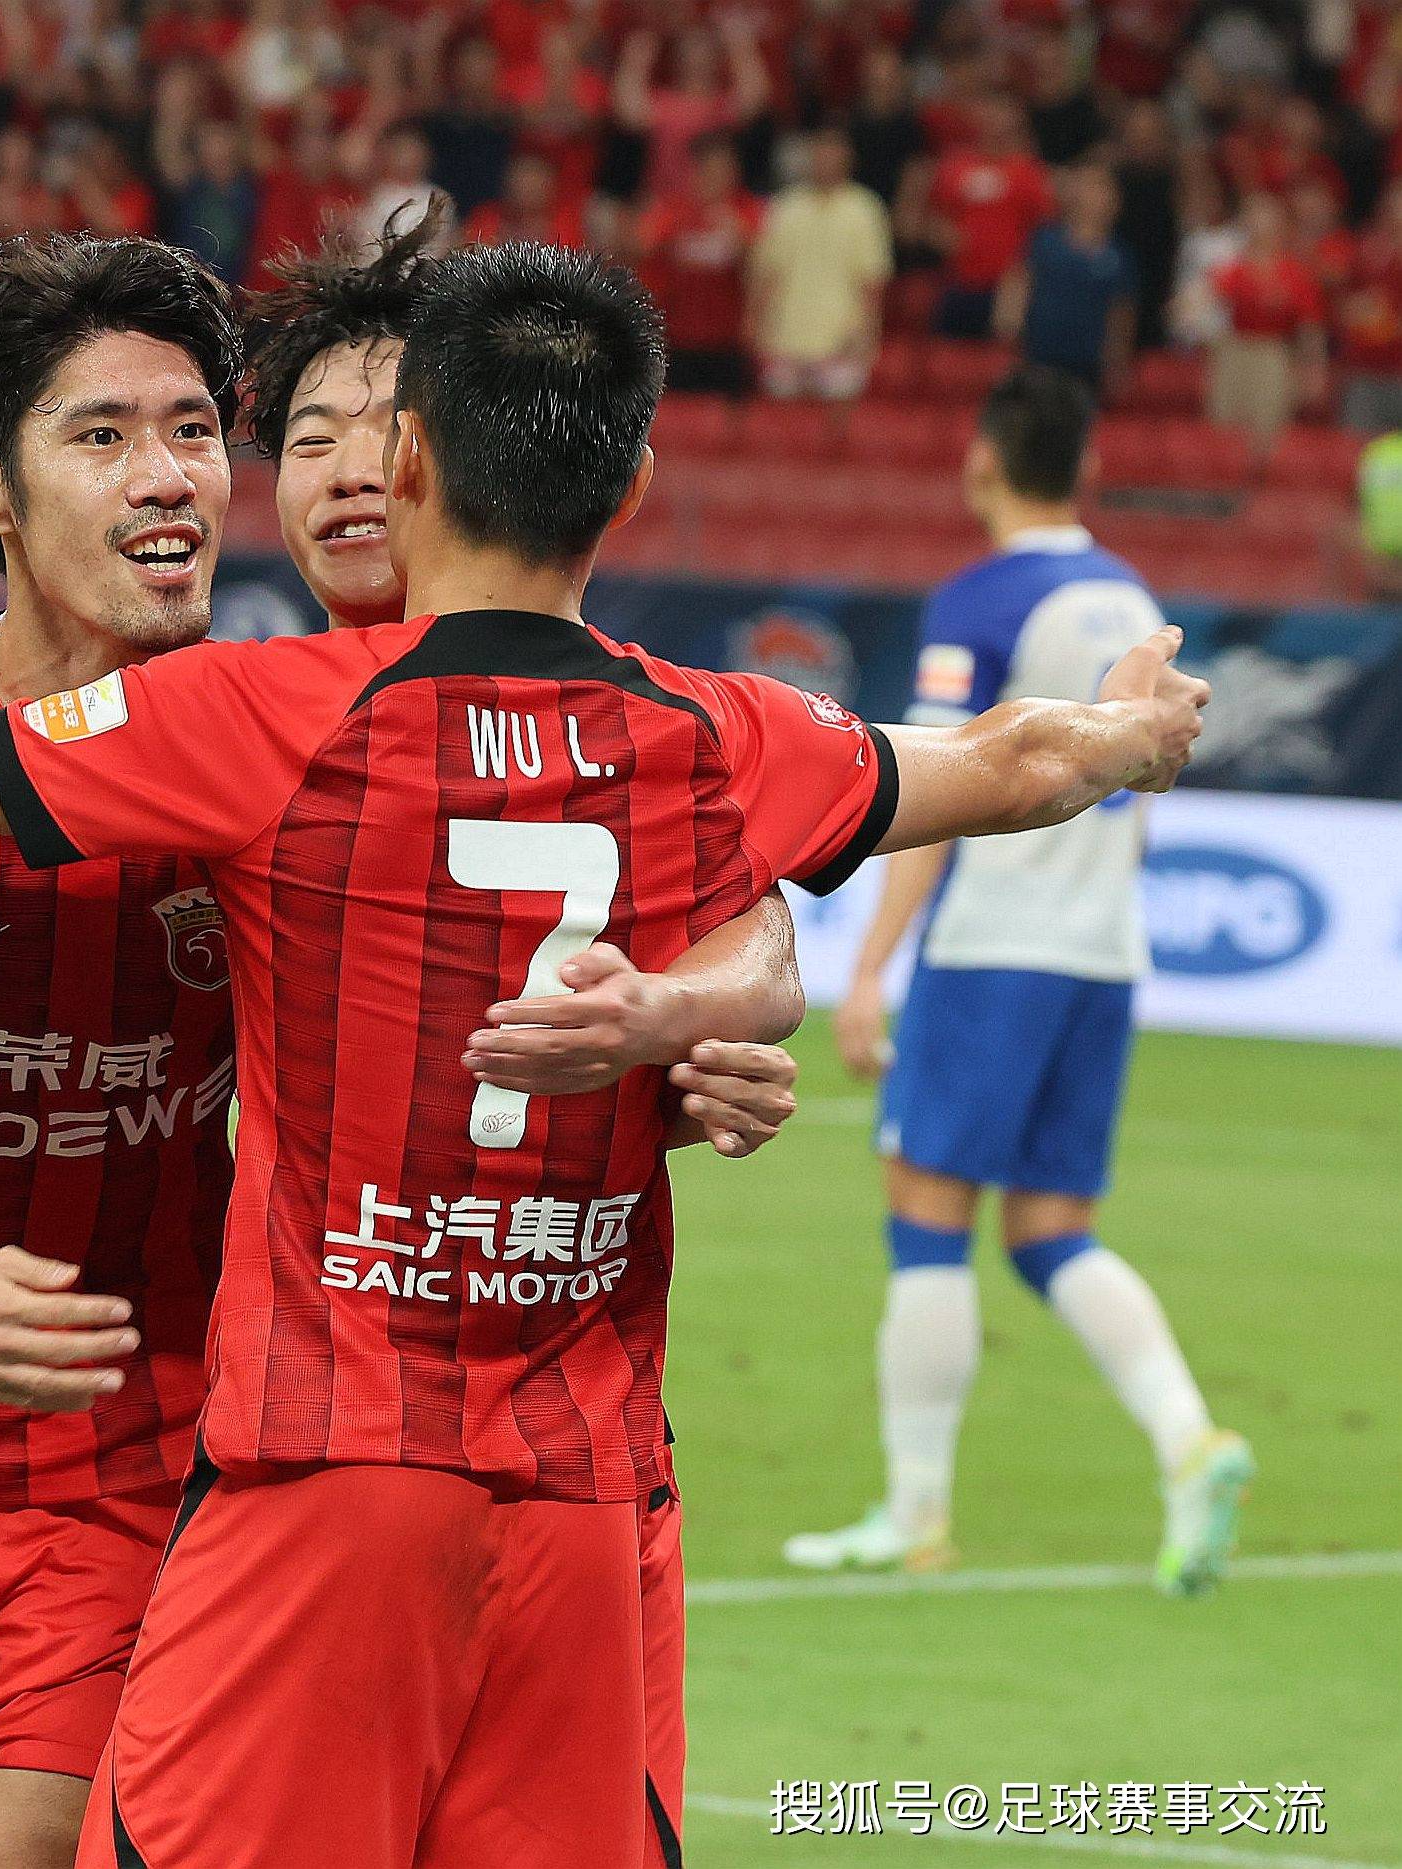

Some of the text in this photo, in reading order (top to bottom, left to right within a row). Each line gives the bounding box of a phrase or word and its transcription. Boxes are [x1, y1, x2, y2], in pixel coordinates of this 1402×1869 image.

[84, 688, 96, 712] CSL
[466, 703, 616, 780] WU L.
[447, 818, 620, 1149] 7
[324, 1182, 642, 1263] 上汽集团
[320, 1254, 628, 1306] SAIC MOTOR
